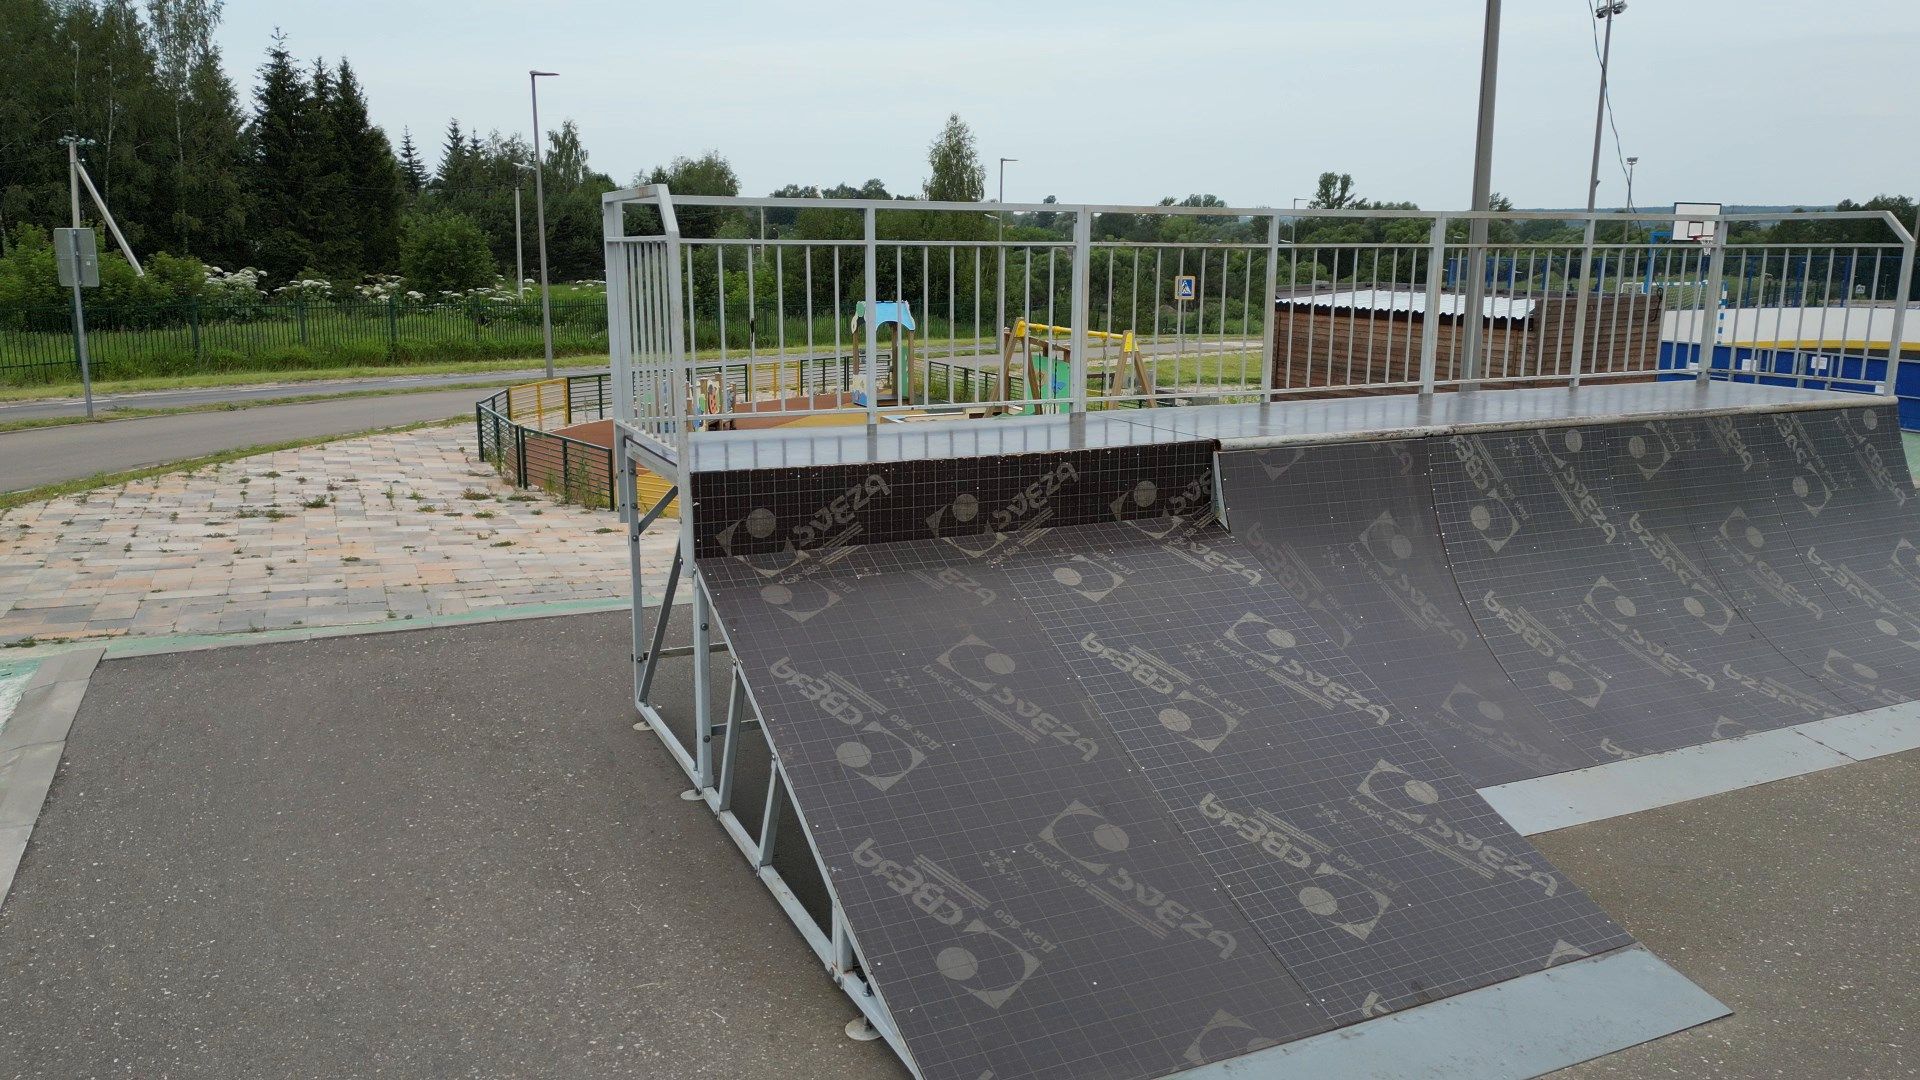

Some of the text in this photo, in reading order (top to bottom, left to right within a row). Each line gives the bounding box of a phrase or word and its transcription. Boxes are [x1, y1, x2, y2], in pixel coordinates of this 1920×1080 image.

[793, 473, 891, 547] SVEZA
[992, 461, 1079, 530] SVEZA
[1169, 469, 1212, 515] SVE
[1563, 466, 1617, 544] SVEZA
[1629, 512, 1693, 586] SVEZA
[937, 567, 997, 607] EZA
[1484, 589, 1555, 657] СВЕЗА
[770, 656, 864, 726] СВЕЗА
[1081, 632, 1175, 694] СВЕЗА
[1281, 658, 1390, 726] SVEZA
[1628, 628, 1716, 691] SVEZA
[992, 686, 1099, 762] SVEZA
[1024, 842, 1061, 870] Deck
[1200, 792, 1312, 868] СВЕЗА
[1428, 818, 1558, 897] SVEZA
[853, 837, 964, 926] СВЕЗА
[1106, 867, 1237, 959] SVEZA
